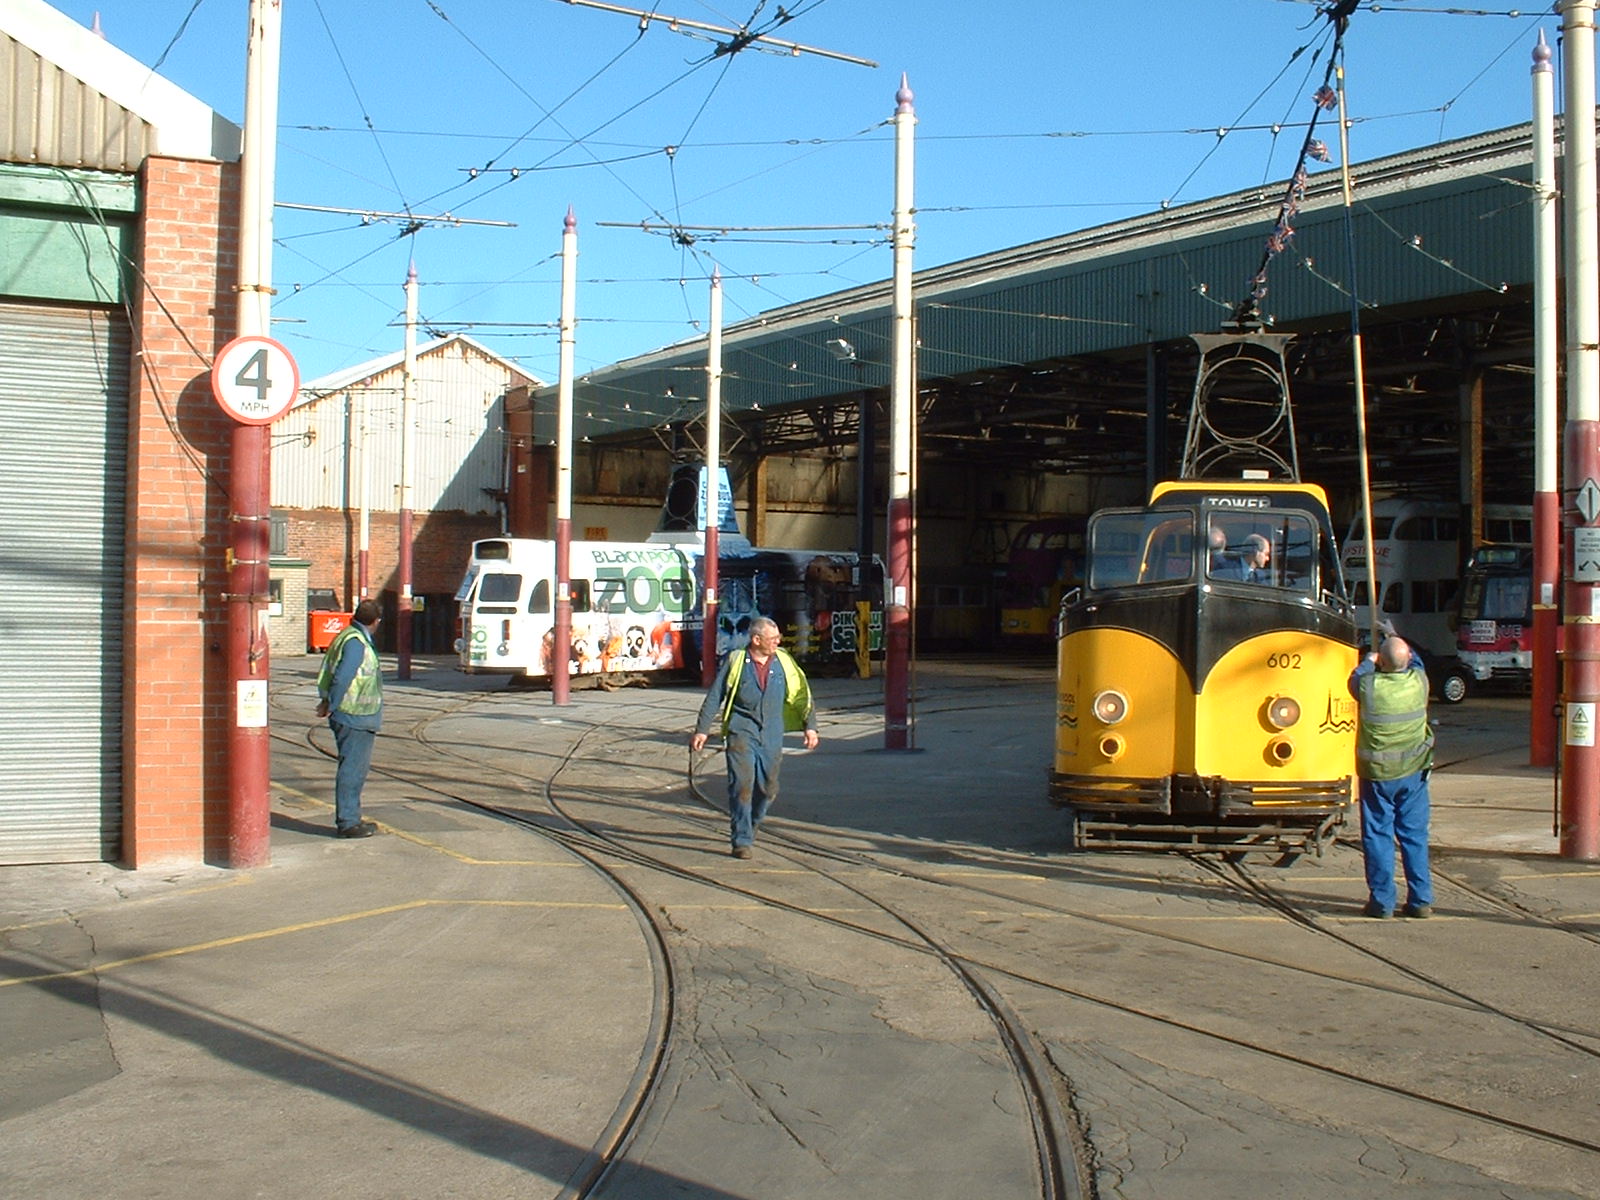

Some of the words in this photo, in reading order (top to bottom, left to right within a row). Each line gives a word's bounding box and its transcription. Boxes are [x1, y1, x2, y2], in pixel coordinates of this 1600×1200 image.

[235, 349, 272, 400] 4
[241, 402, 270, 412] MPH
[595, 566, 694, 614] ZOO
[1267, 653, 1302, 669] 602
